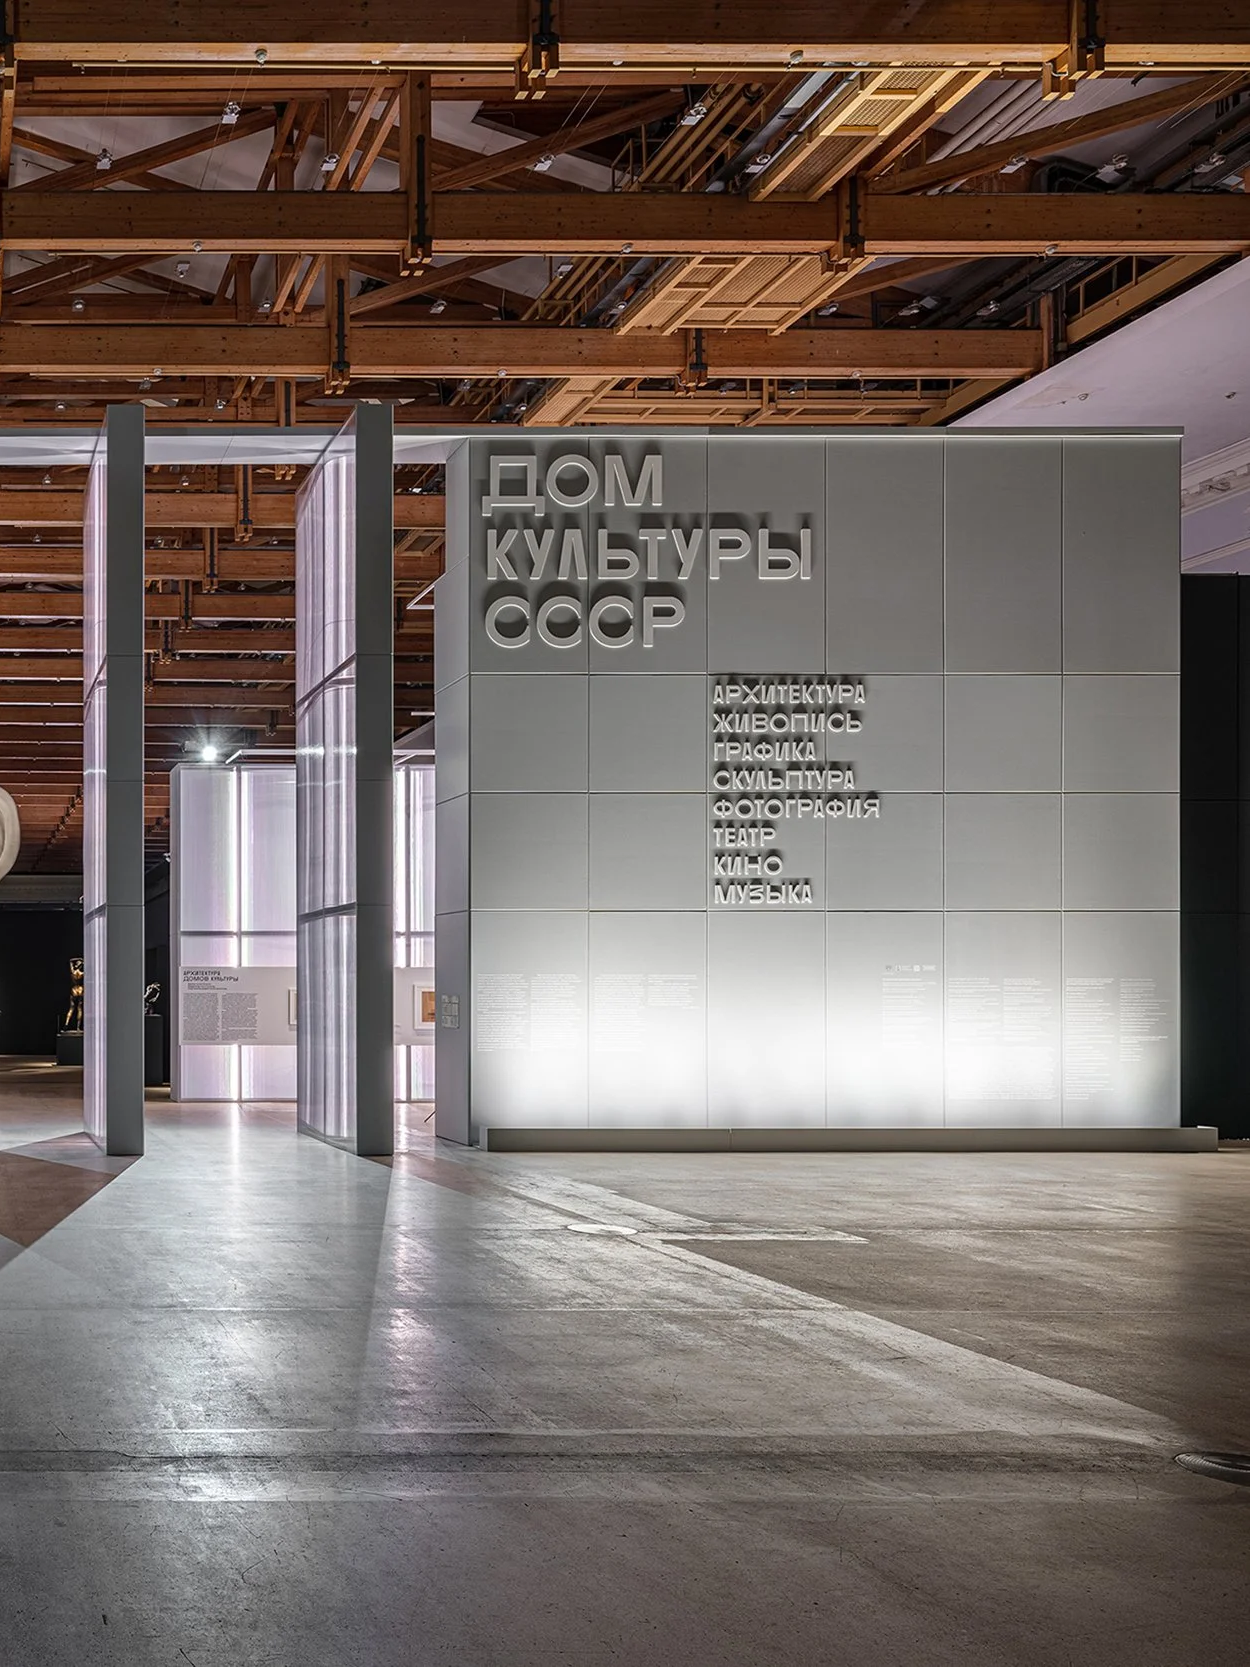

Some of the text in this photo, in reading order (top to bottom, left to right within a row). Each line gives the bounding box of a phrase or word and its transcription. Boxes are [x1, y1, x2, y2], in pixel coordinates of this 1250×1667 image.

[481, 453, 663, 517] ДОМ
[486, 528, 812, 581] КУЛЬТУРЫ
[485, 595, 686, 649] СССР
[713, 684, 866, 704] АРХИТЕКТУРА
[713, 712, 864, 733] ЖИВОПИСЬ
[713, 741, 817, 761] ГРАФИКА
[713, 769, 855, 790] СКУЛЬПТУРА
[713, 798, 880, 818] ФОТОГРАФИЯ
[713, 827, 776, 847] ТЕАТР
[714, 855, 783, 875] КИНО
[714, 884, 813, 904] МУЗЫКА
